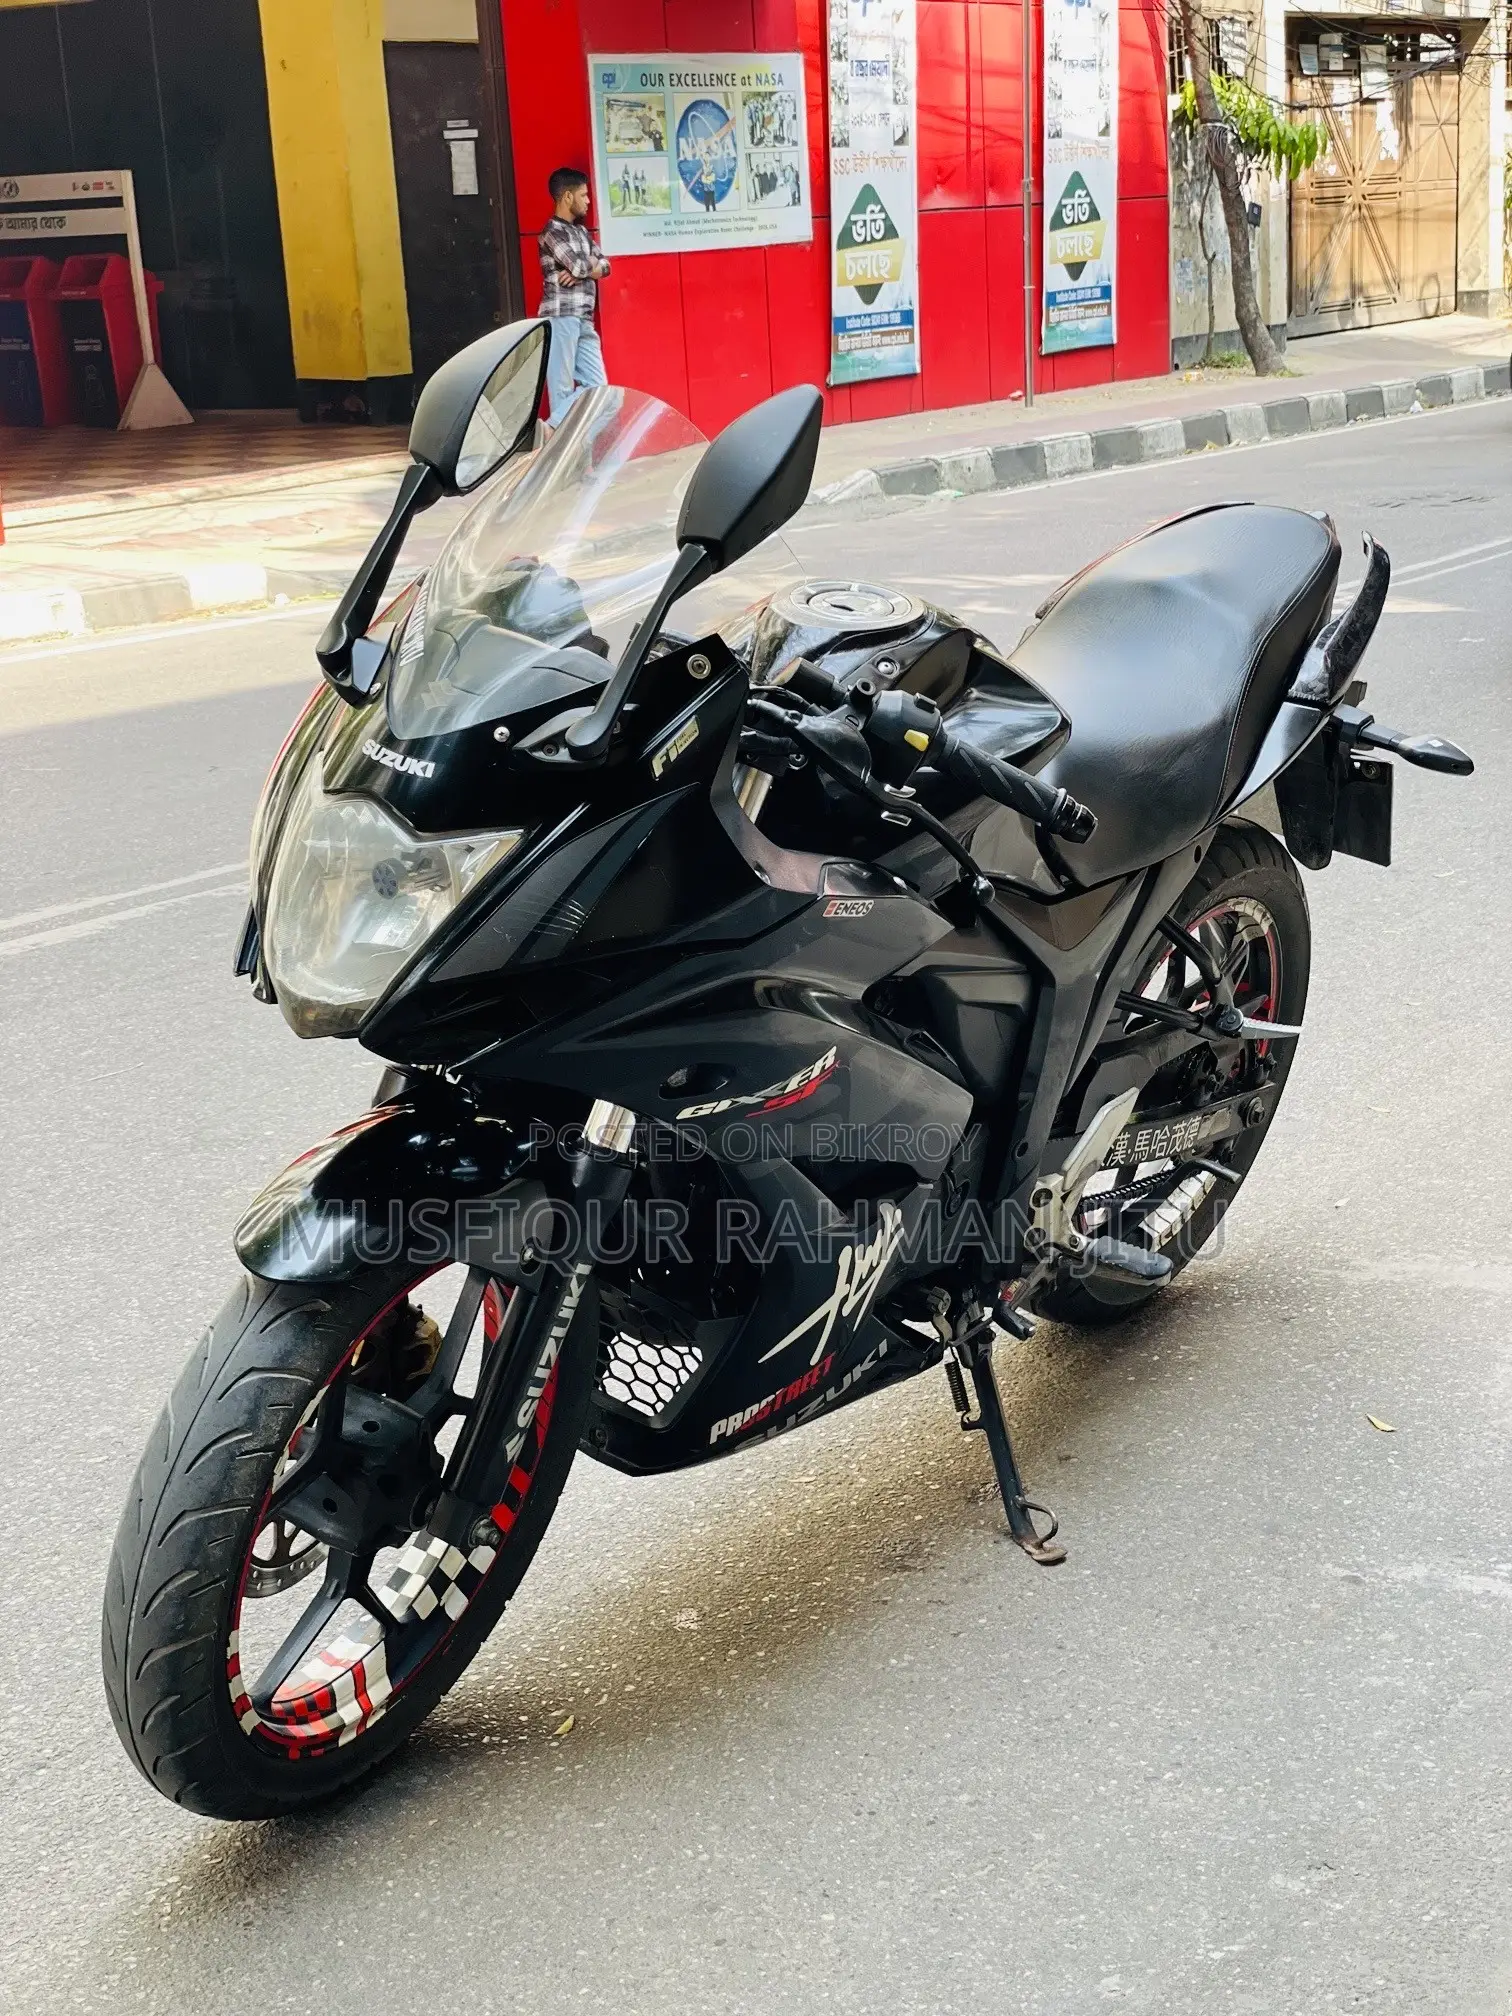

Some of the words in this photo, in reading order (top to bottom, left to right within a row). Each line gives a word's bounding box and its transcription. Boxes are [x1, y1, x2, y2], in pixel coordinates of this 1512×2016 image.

[640, 73, 665, 87] OUR
[669, 73, 737, 87] EXCELLENCE
[740, 74, 752, 87] at
[755, 72, 784, 87] NASA
[5, 217, 38, 231] আমার
[40, 215, 67, 230] থেকে
[850, 203, 886, 243] ভর্তি
[1061, 189, 1090, 225] ভর্তি
[1055, 230, 1096, 259] চলছে
[844, 249, 892, 281] চলছে
[361, 738, 436, 779] SUZUKI
[833, 901, 874, 916] ENEOS
[675, 1045, 838, 1120] GIXXER
[516, 1262, 593, 1429] SUZUKI
